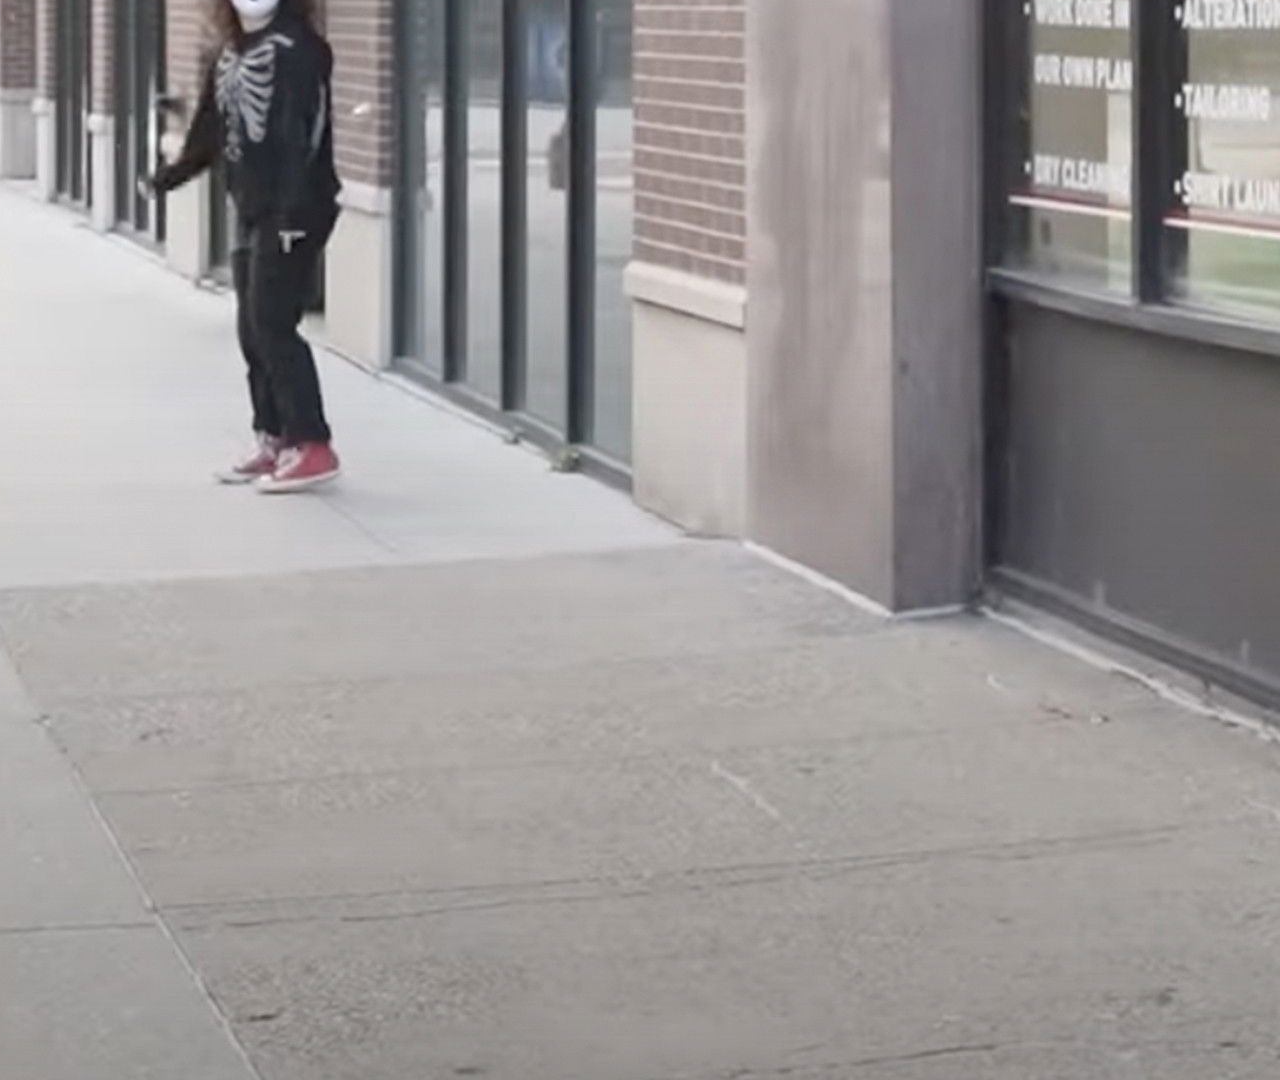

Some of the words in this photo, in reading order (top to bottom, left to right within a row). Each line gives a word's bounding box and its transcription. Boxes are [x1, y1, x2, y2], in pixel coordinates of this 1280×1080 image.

[1034, 53, 1061, 86] OUR
[1063, 55, 1095, 88] OWN
[1182, 83, 1270, 120] TAILORING
